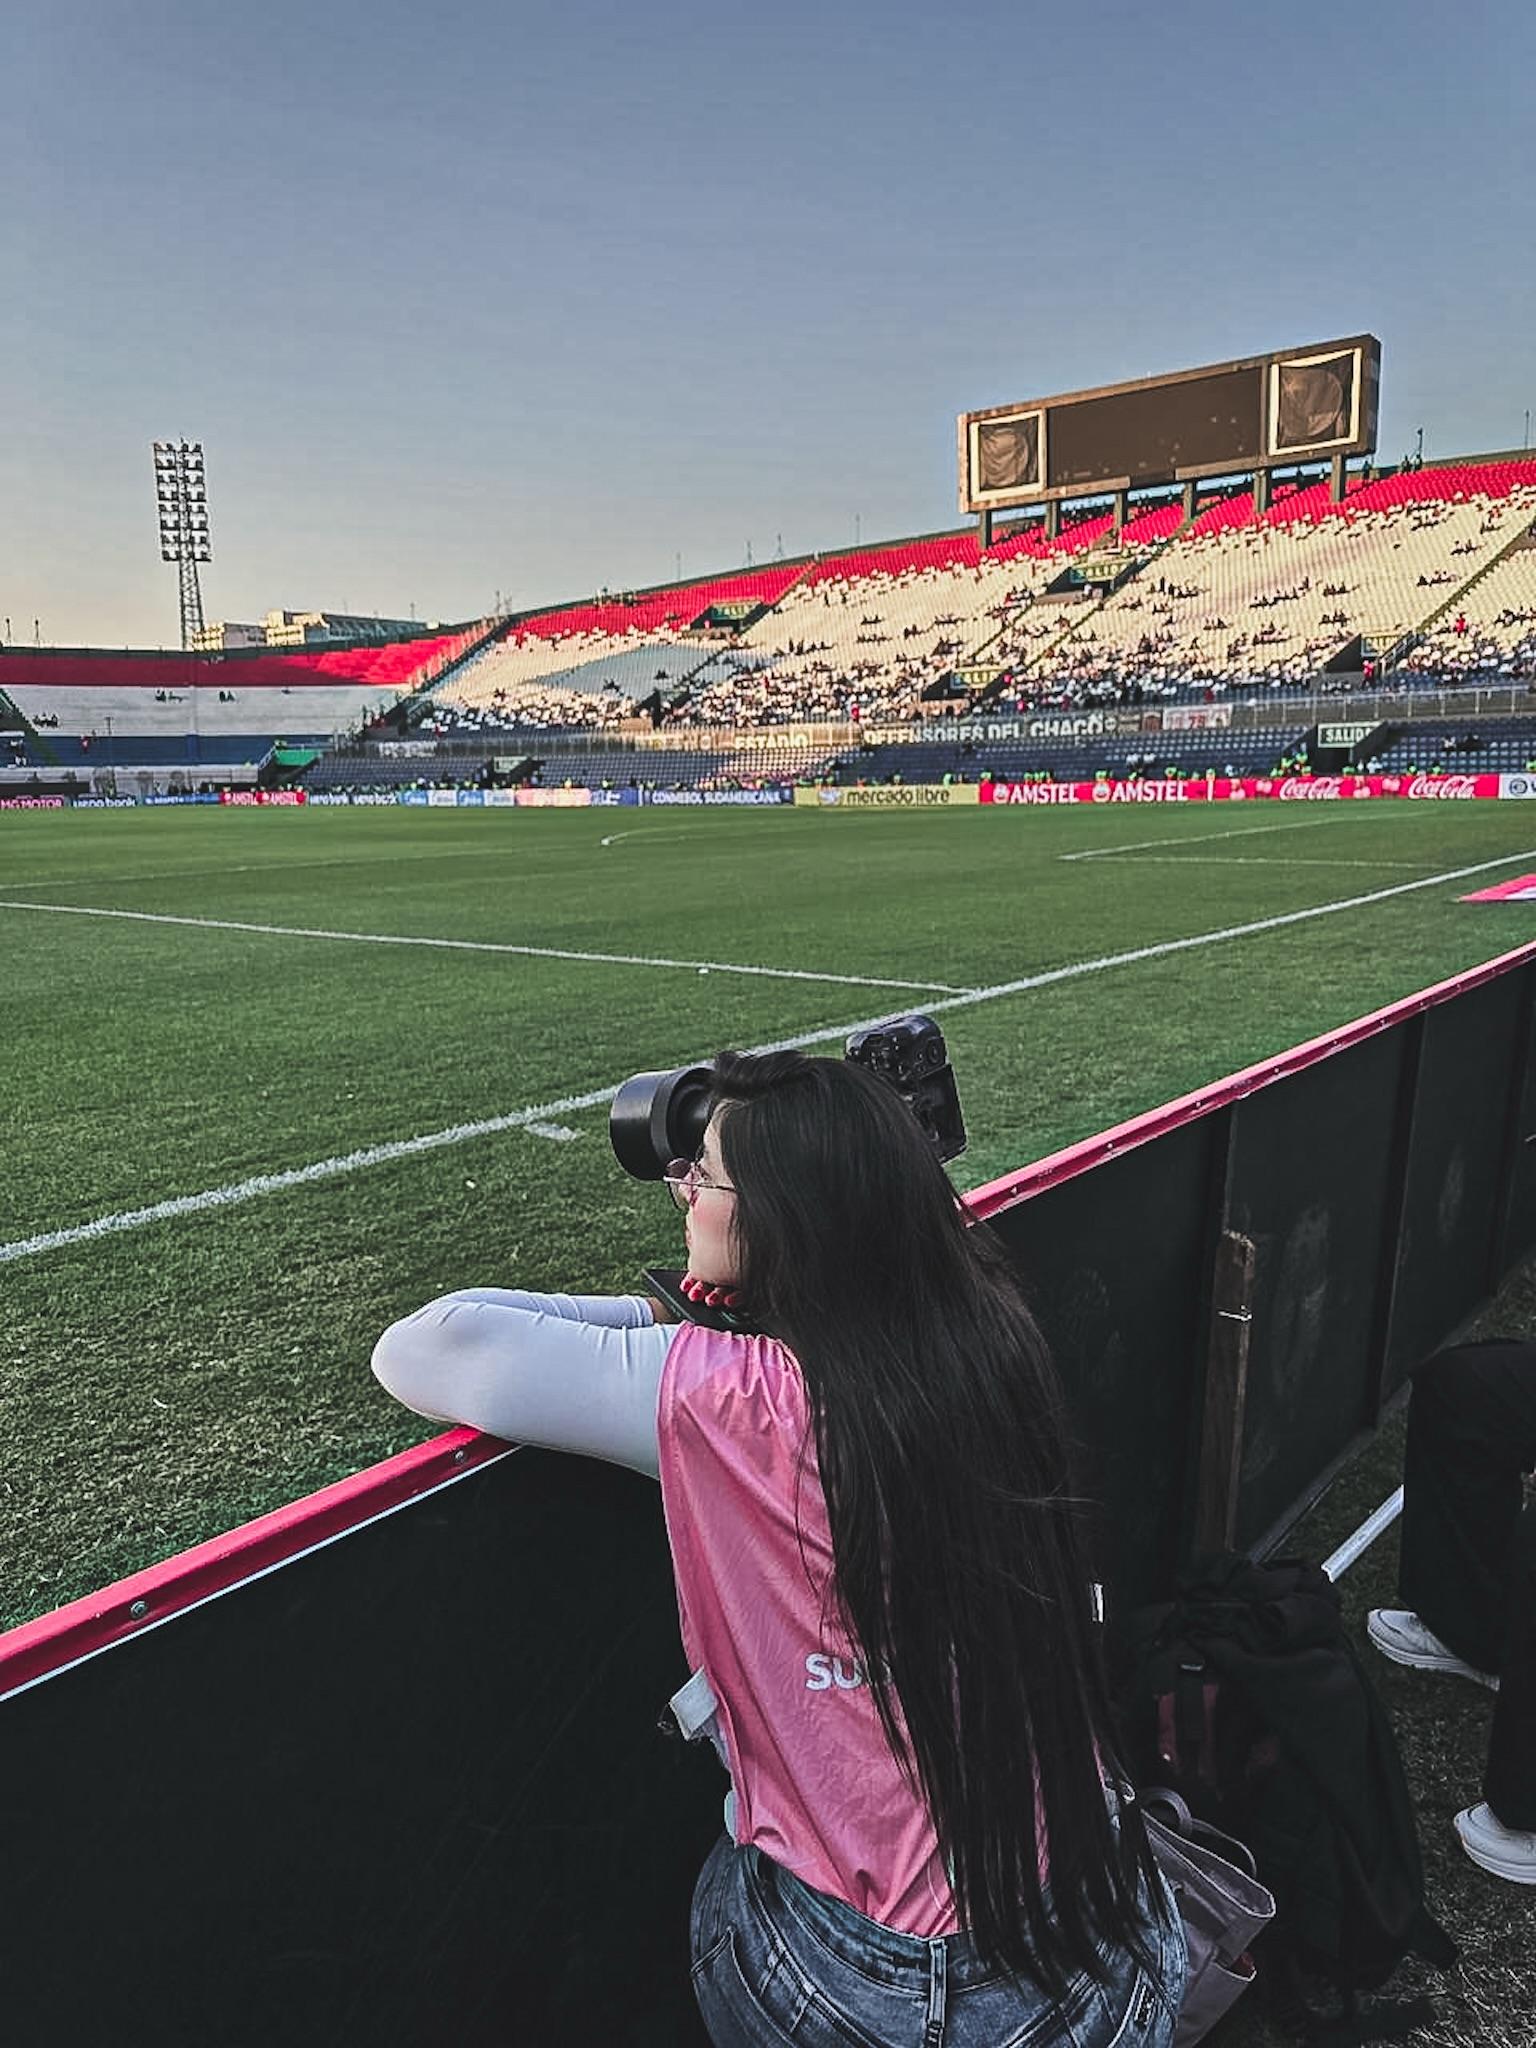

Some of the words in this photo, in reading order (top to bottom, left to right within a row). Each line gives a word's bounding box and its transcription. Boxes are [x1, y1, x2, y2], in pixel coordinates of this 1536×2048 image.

[734, 733, 809, 750] ESTADIO
[987, 723, 1021, 740] DEL
[1030, 716, 1101, 738] CHACO
[847, 787, 914, 804] mercado
[915, 785, 950, 803] libre
[1010, 783, 1080, 803] AMSTEL
[1111, 780, 1189, 802] AMSTEL
